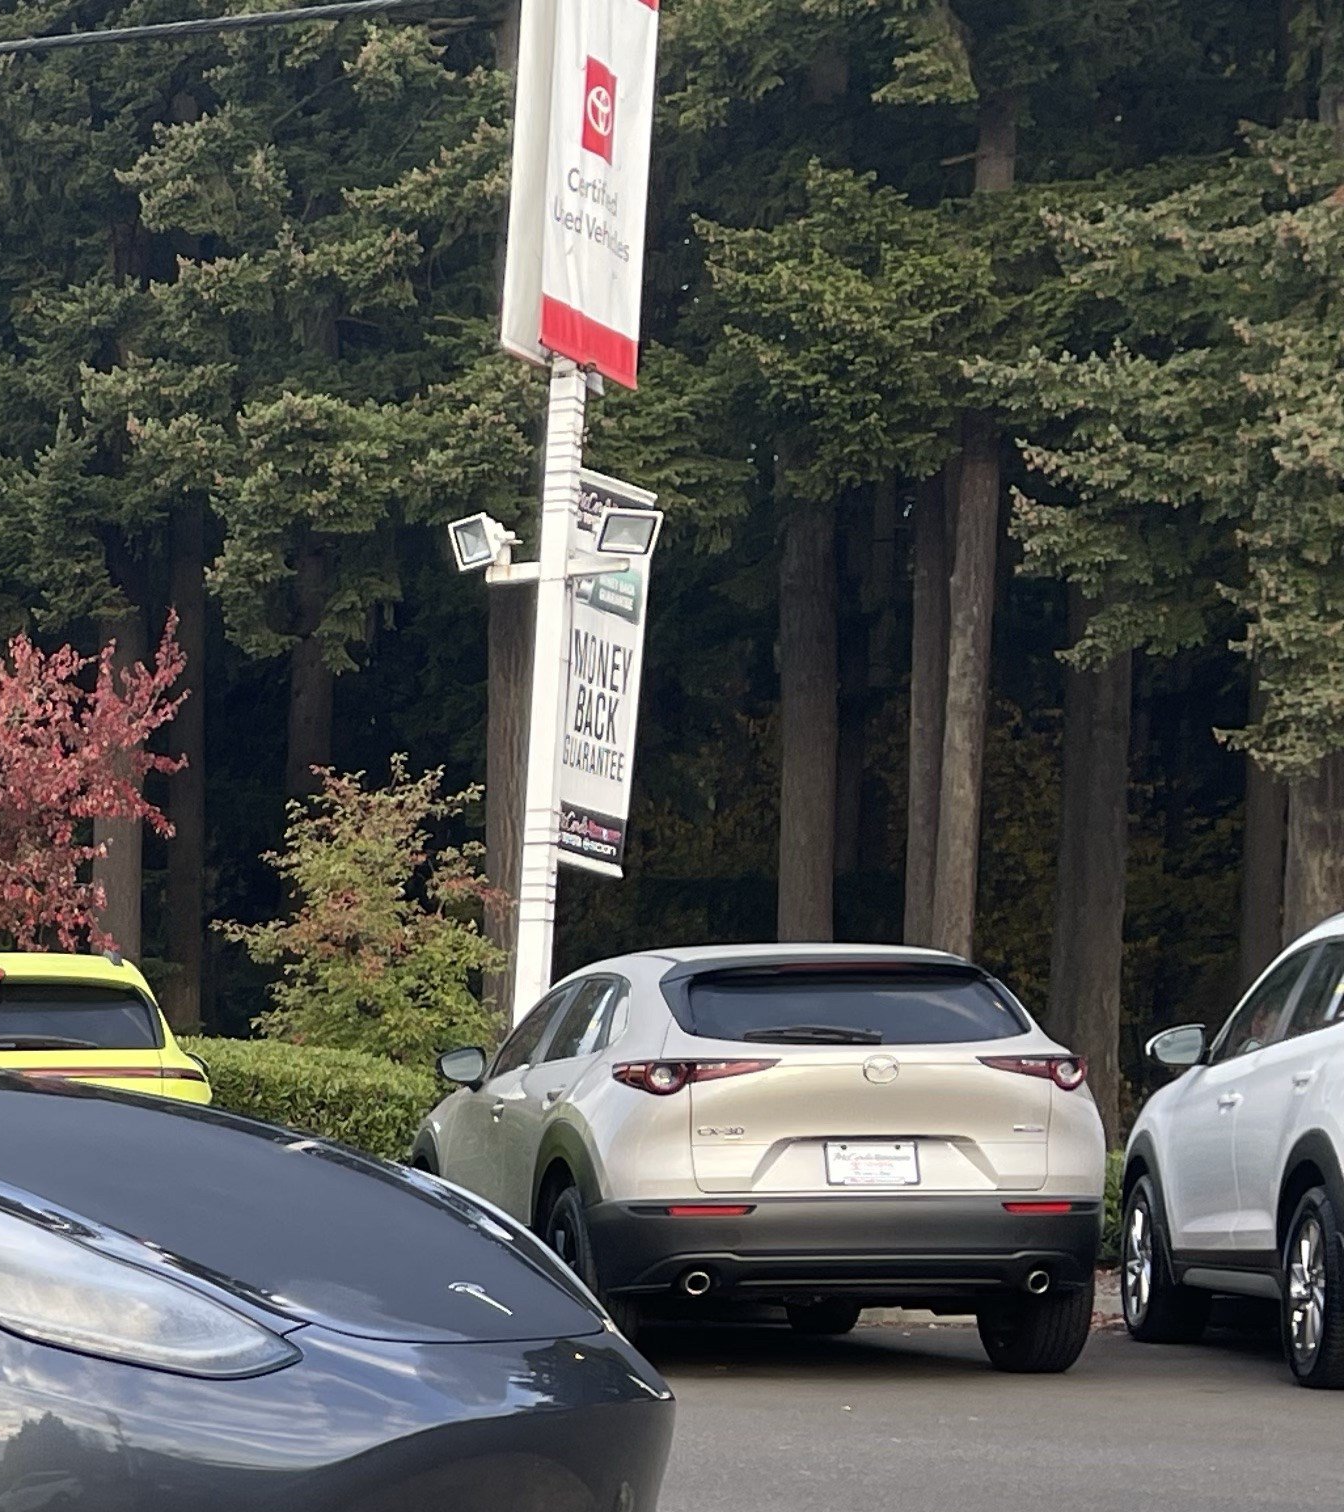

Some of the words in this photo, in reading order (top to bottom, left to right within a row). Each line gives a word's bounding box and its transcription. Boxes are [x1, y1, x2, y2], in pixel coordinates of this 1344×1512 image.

[567, 167, 618, 217] Certifd
[553, 195, 584, 234] Ued
[585, 212, 630, 263] Vehles
[573, 628, 633, 695] MONEY
[573, 683, 620, 745] BACK
[562, 734, 625, 782] GUARANTEE
